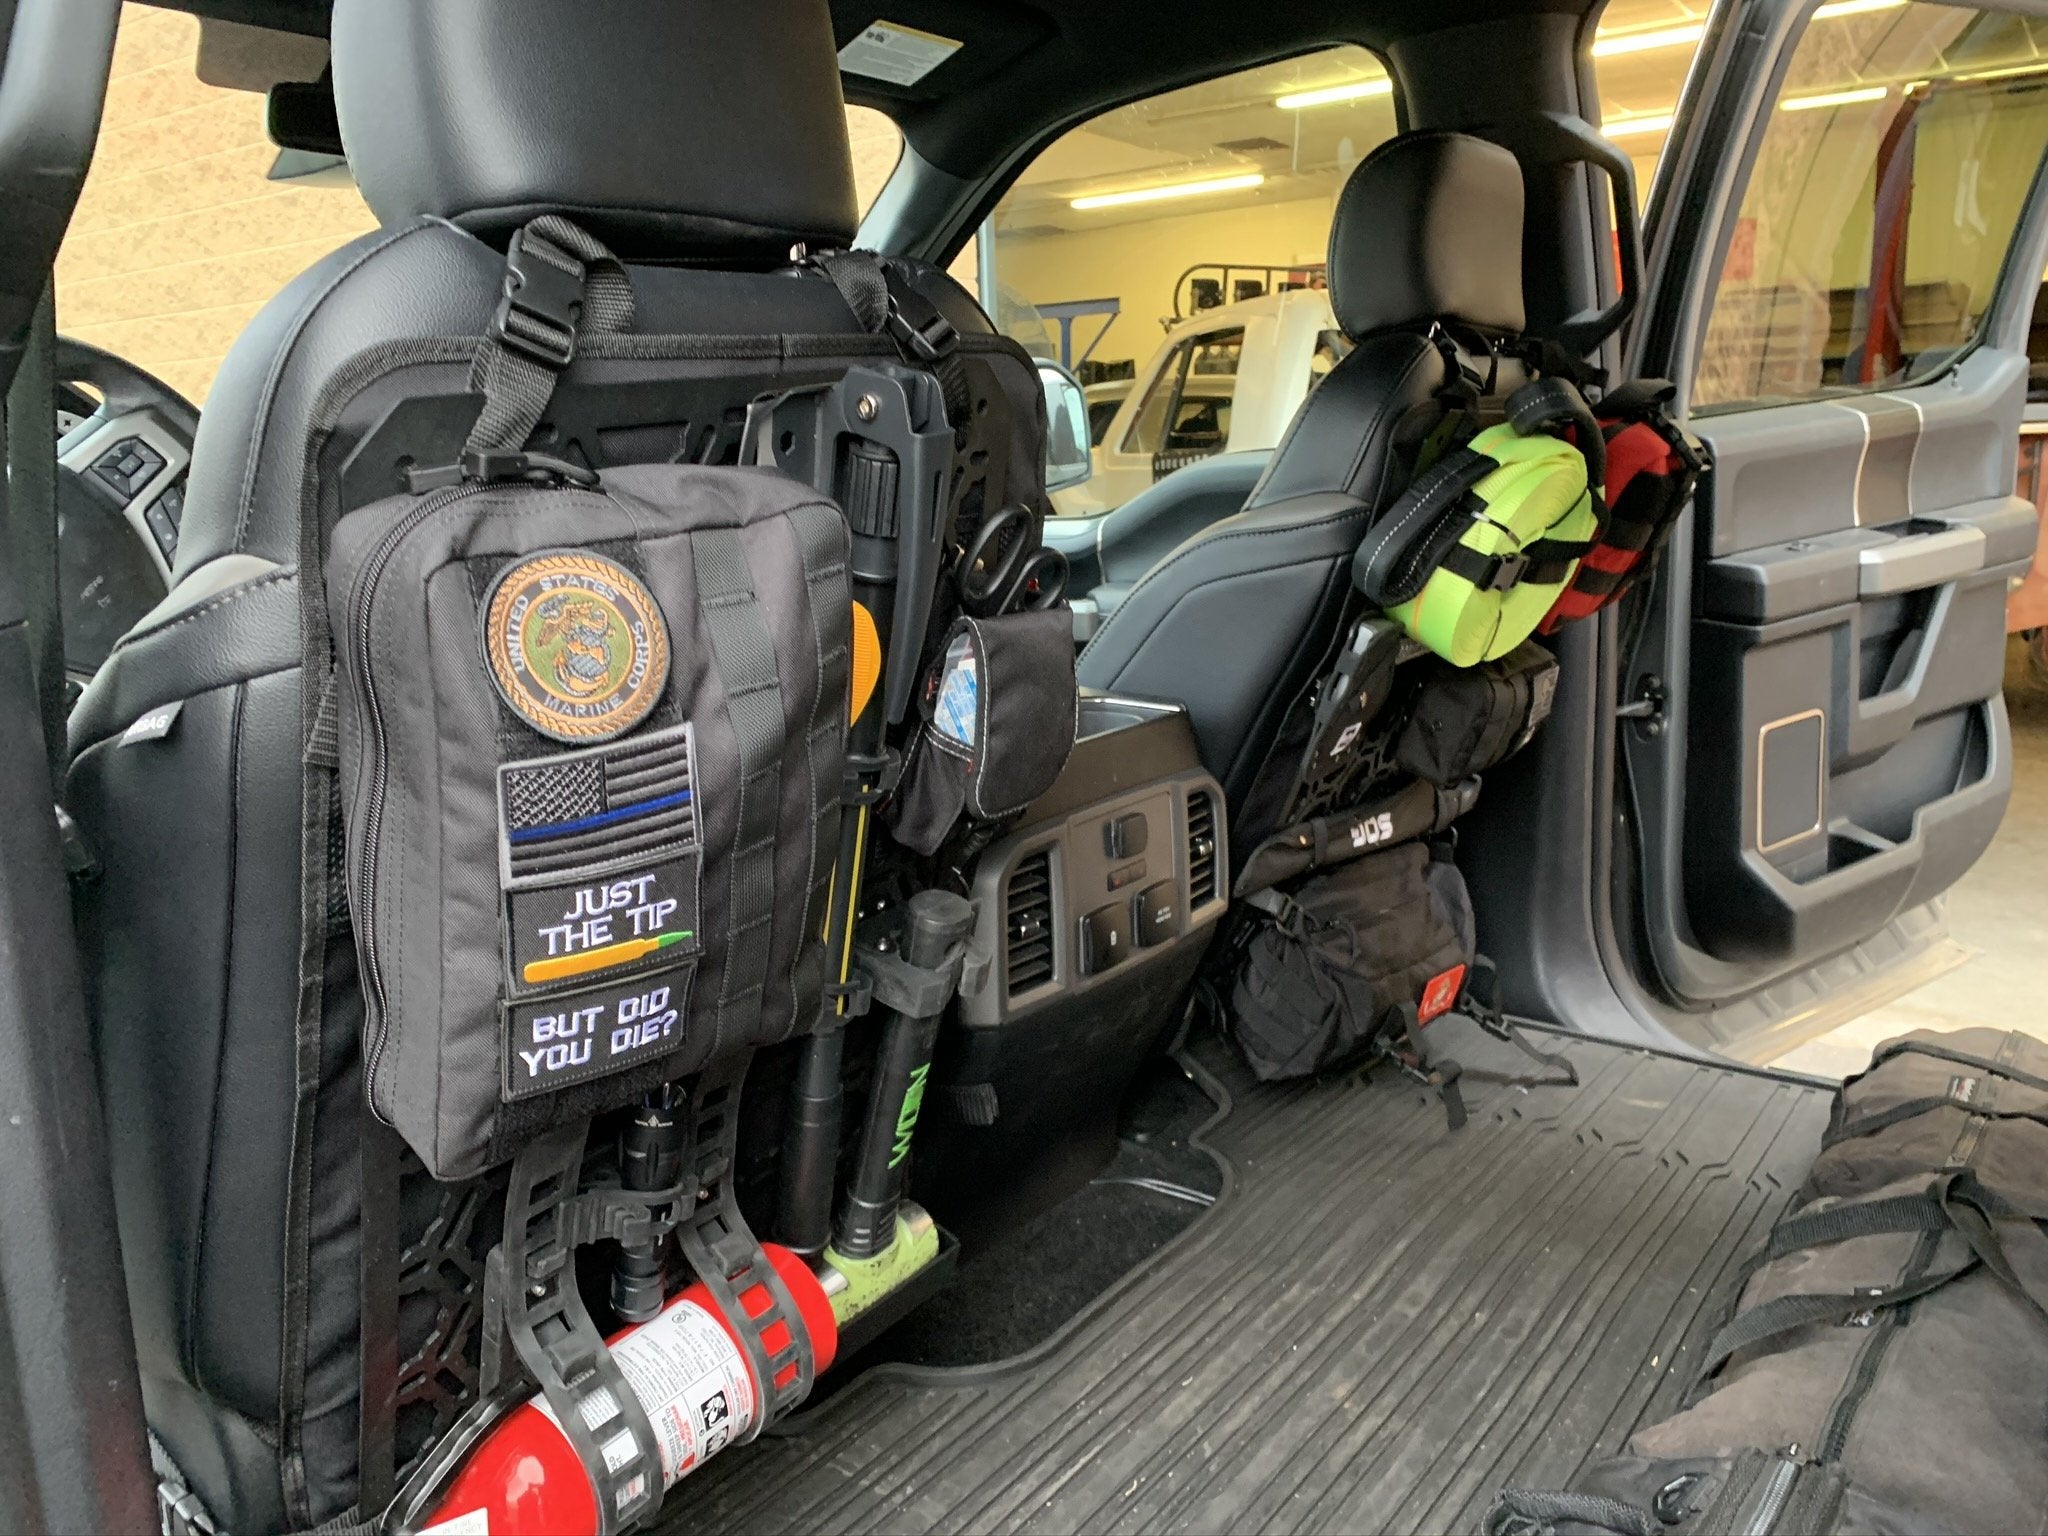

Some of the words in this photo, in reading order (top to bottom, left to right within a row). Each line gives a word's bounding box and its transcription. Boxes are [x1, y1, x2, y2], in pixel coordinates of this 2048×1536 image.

[506, 595, 529, 672] UNITED
[540, 574, 619, 601] STATES
[543, 692, 625, 717] MARINE
[627, 620, 650, 689] CORPS
[538, 914, 613, 955] THE
[625, 898, 678, 935] TIP
[563, 873, 656, 920] JUST
[518, 1038, 592, 1078] YOU
[610, 1009, 678, 1055] DIE?
[532, 1005, 605, 1043] BUT
[617, 986, 670, 1025] DID
